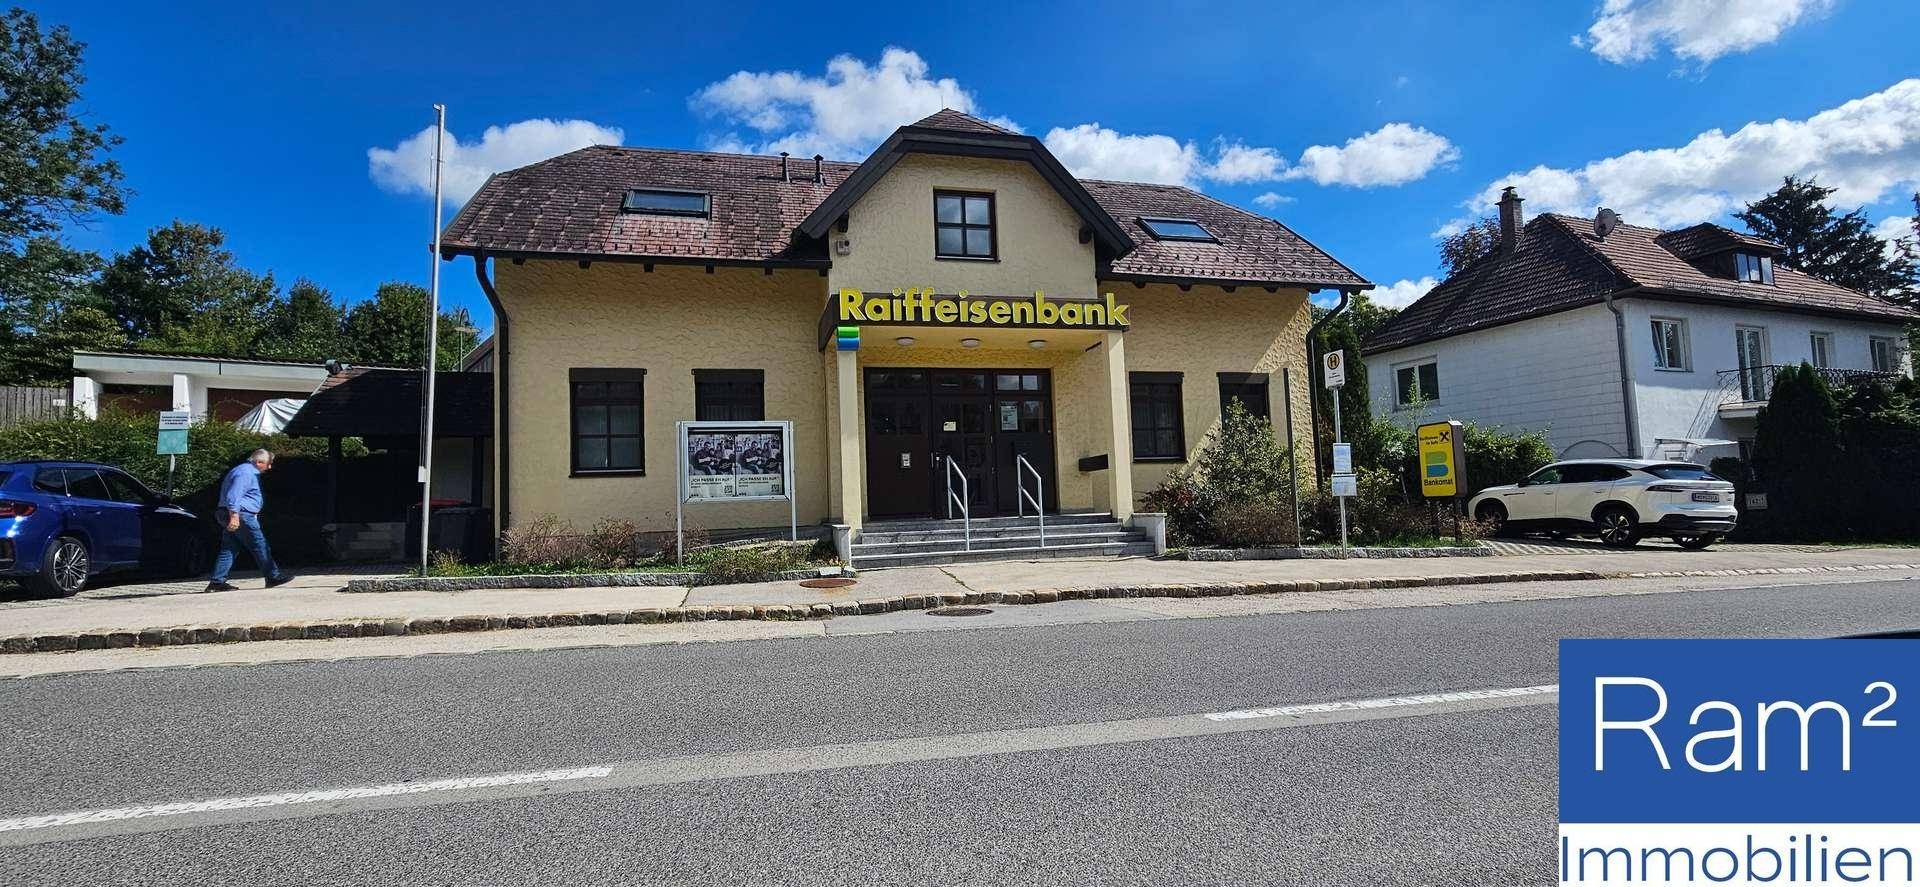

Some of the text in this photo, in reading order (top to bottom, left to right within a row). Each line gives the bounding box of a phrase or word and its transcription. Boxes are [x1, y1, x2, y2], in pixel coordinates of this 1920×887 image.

[838, 287, 1130, 326] Raiffeisenbank
[1329, 355, 1338, 368] H
[1423, 478, 1453, 487] Bankomat
